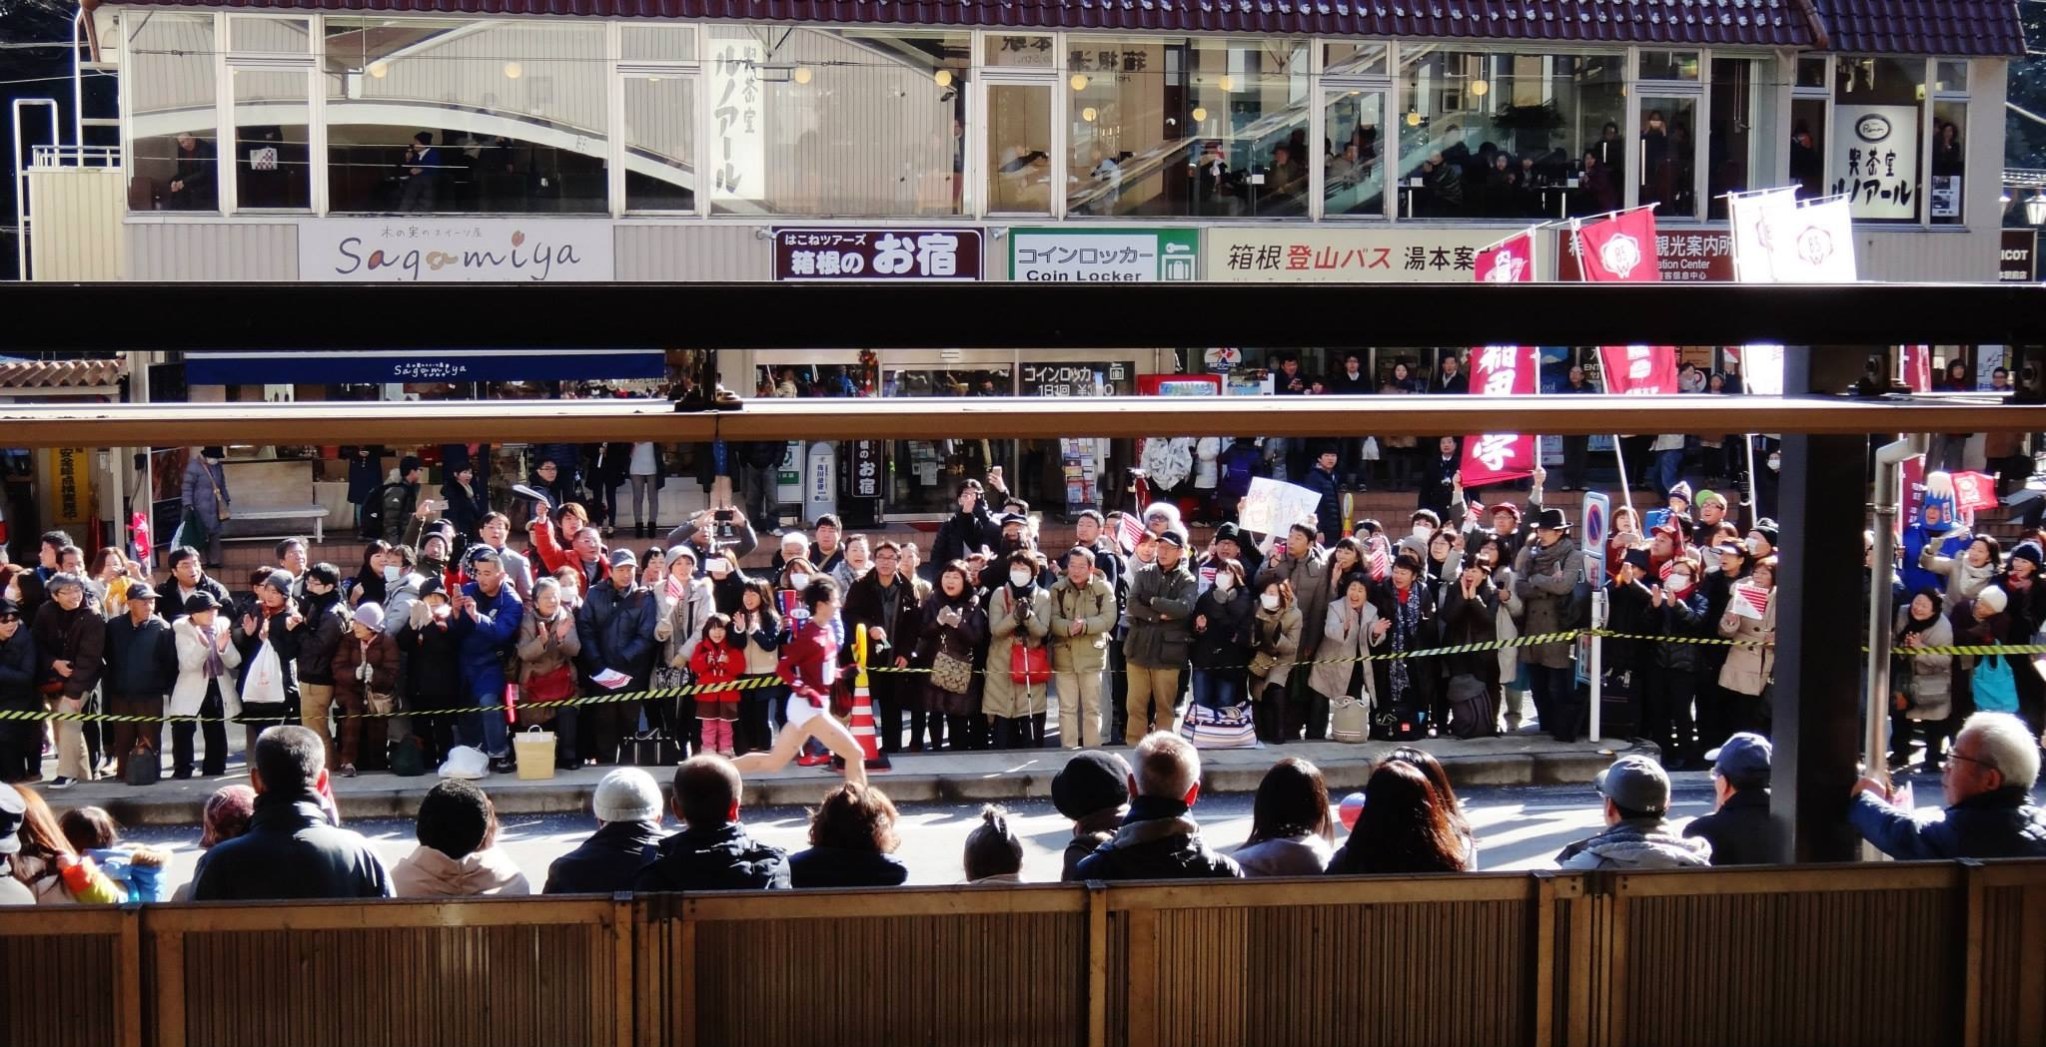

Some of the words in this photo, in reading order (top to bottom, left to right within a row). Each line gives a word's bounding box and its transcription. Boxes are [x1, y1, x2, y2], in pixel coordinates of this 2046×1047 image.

[714, 45, 742, 194] ルノアール
[1849, 146, 1896, 176] 喫茶室
[1832, 178, 1913, 206] ルノアール
[784, 234, 867, 246] はこねツアーズ
[335, 230, 580, 280] Sagamiya
[1018, 245, 1154, 265] コインロッカー
[1226, 244, 1391, 271] 箱根登山バス
[1403, 246, 1490, 271] 湯本案
[1680, 258, 1711, 270] Center
[1026, 269, 1069, 281] Coin
[1076, 269, 1143, 281] Locker
[1024, 366, 1097, 383] コインロッカ
